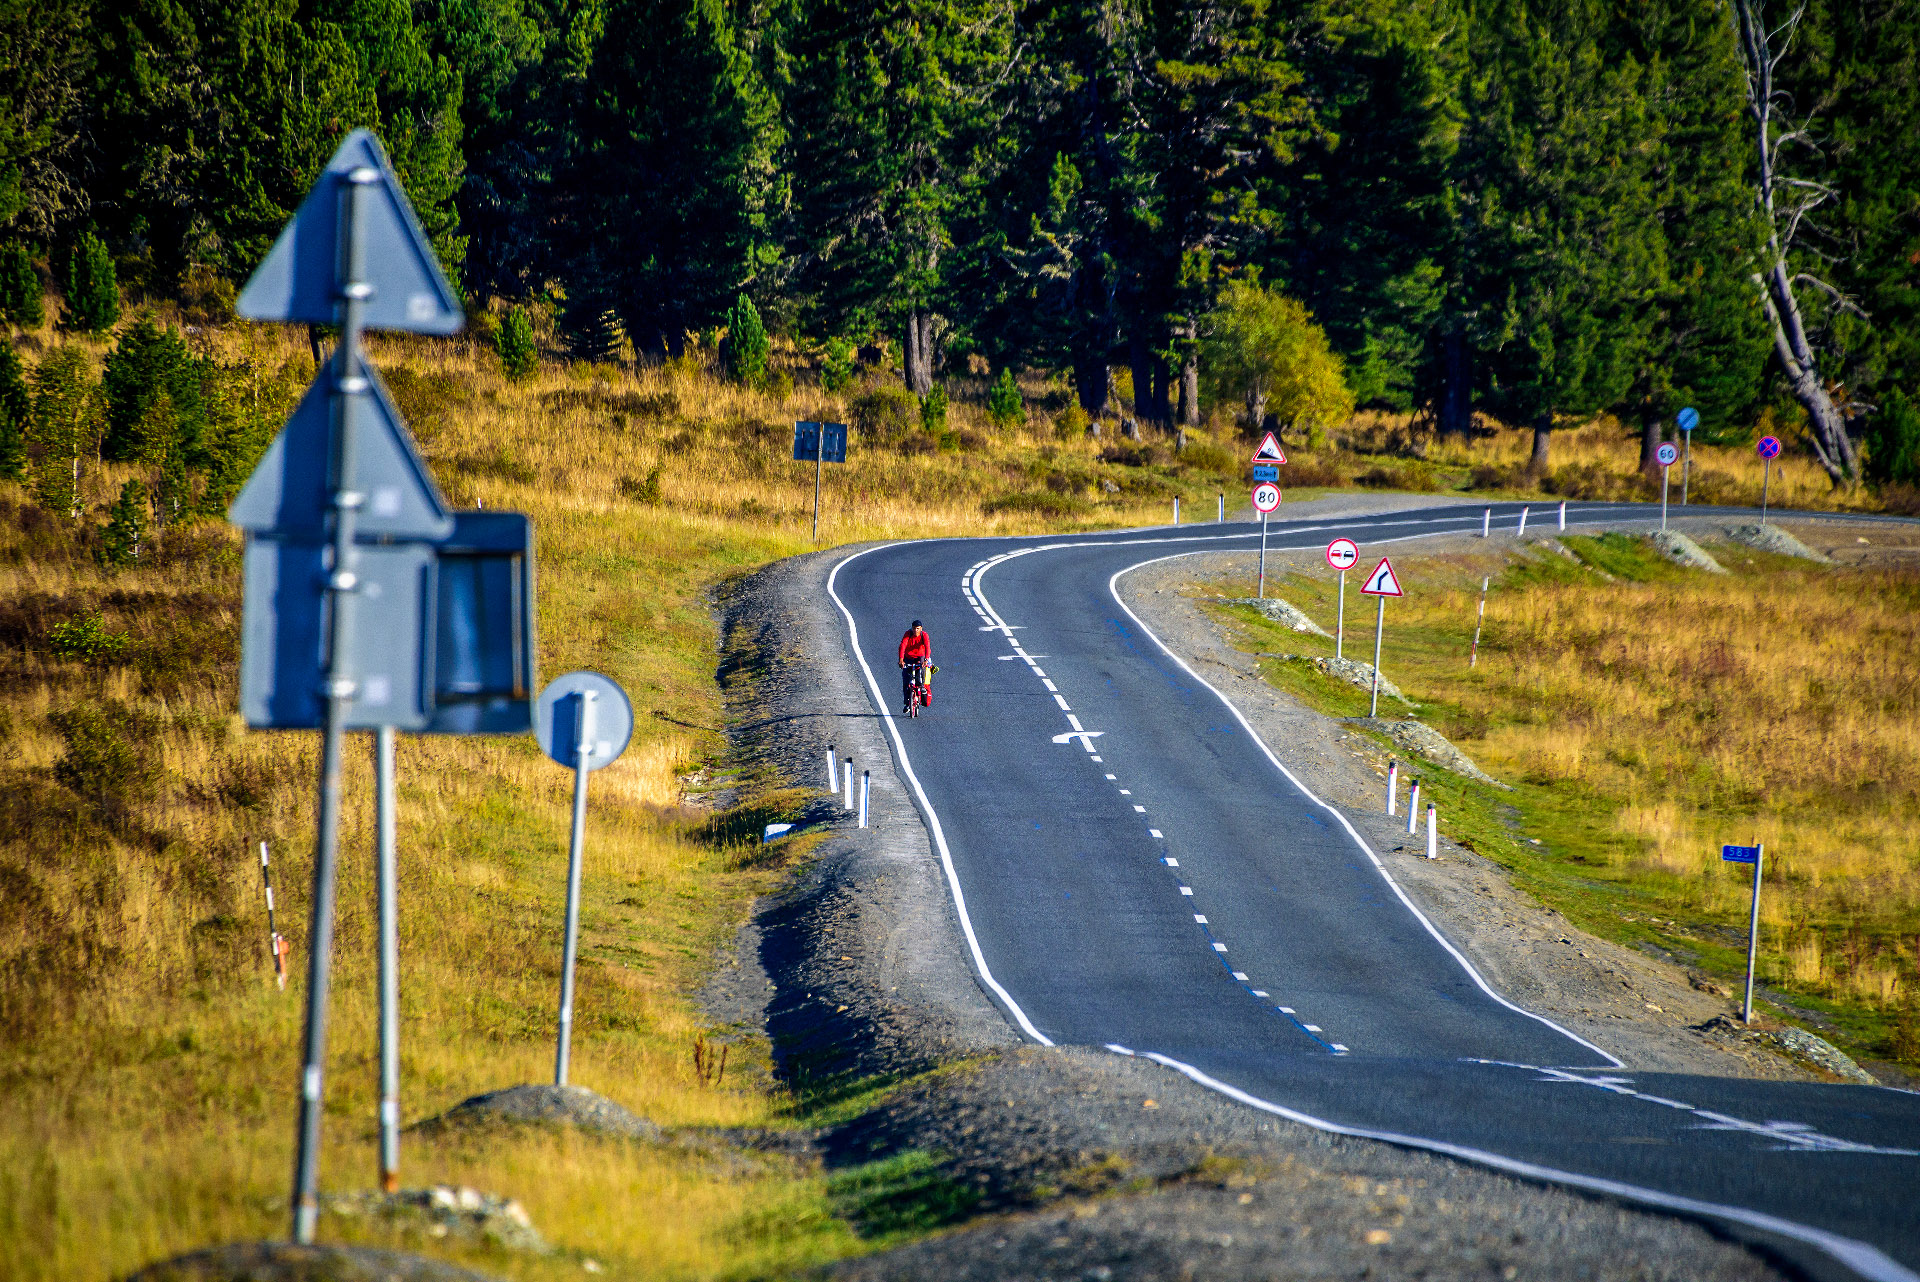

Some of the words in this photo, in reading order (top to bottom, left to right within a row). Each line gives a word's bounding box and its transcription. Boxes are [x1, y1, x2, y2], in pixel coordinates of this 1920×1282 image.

[1660, 449, 1674, 459] 60
[1258, 491, 1275, 503] 80
[1729, 847, 1750, 857] 583
